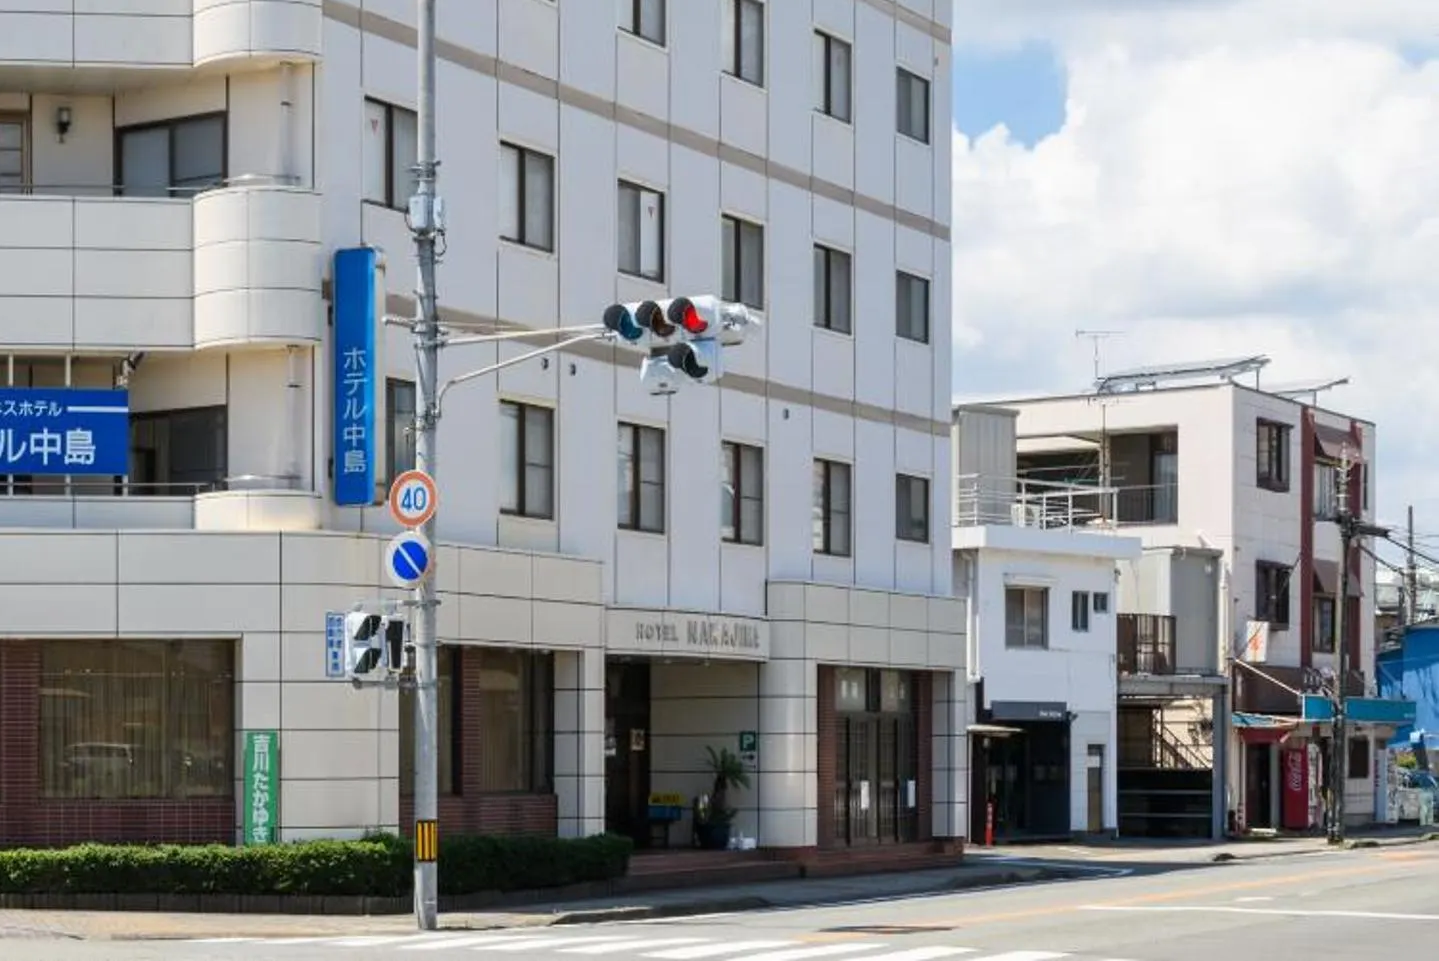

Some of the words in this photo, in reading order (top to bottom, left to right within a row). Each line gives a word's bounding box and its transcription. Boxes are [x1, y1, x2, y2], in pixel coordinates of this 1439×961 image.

[343, 346, 366, 473] ホテル中島
[400, 487, 427, 511] 40
[635, 621, 679, 642] HOTEL
[686, 620, 760, 650] NAKAJIMA
[742, 735, 754, 749] P
